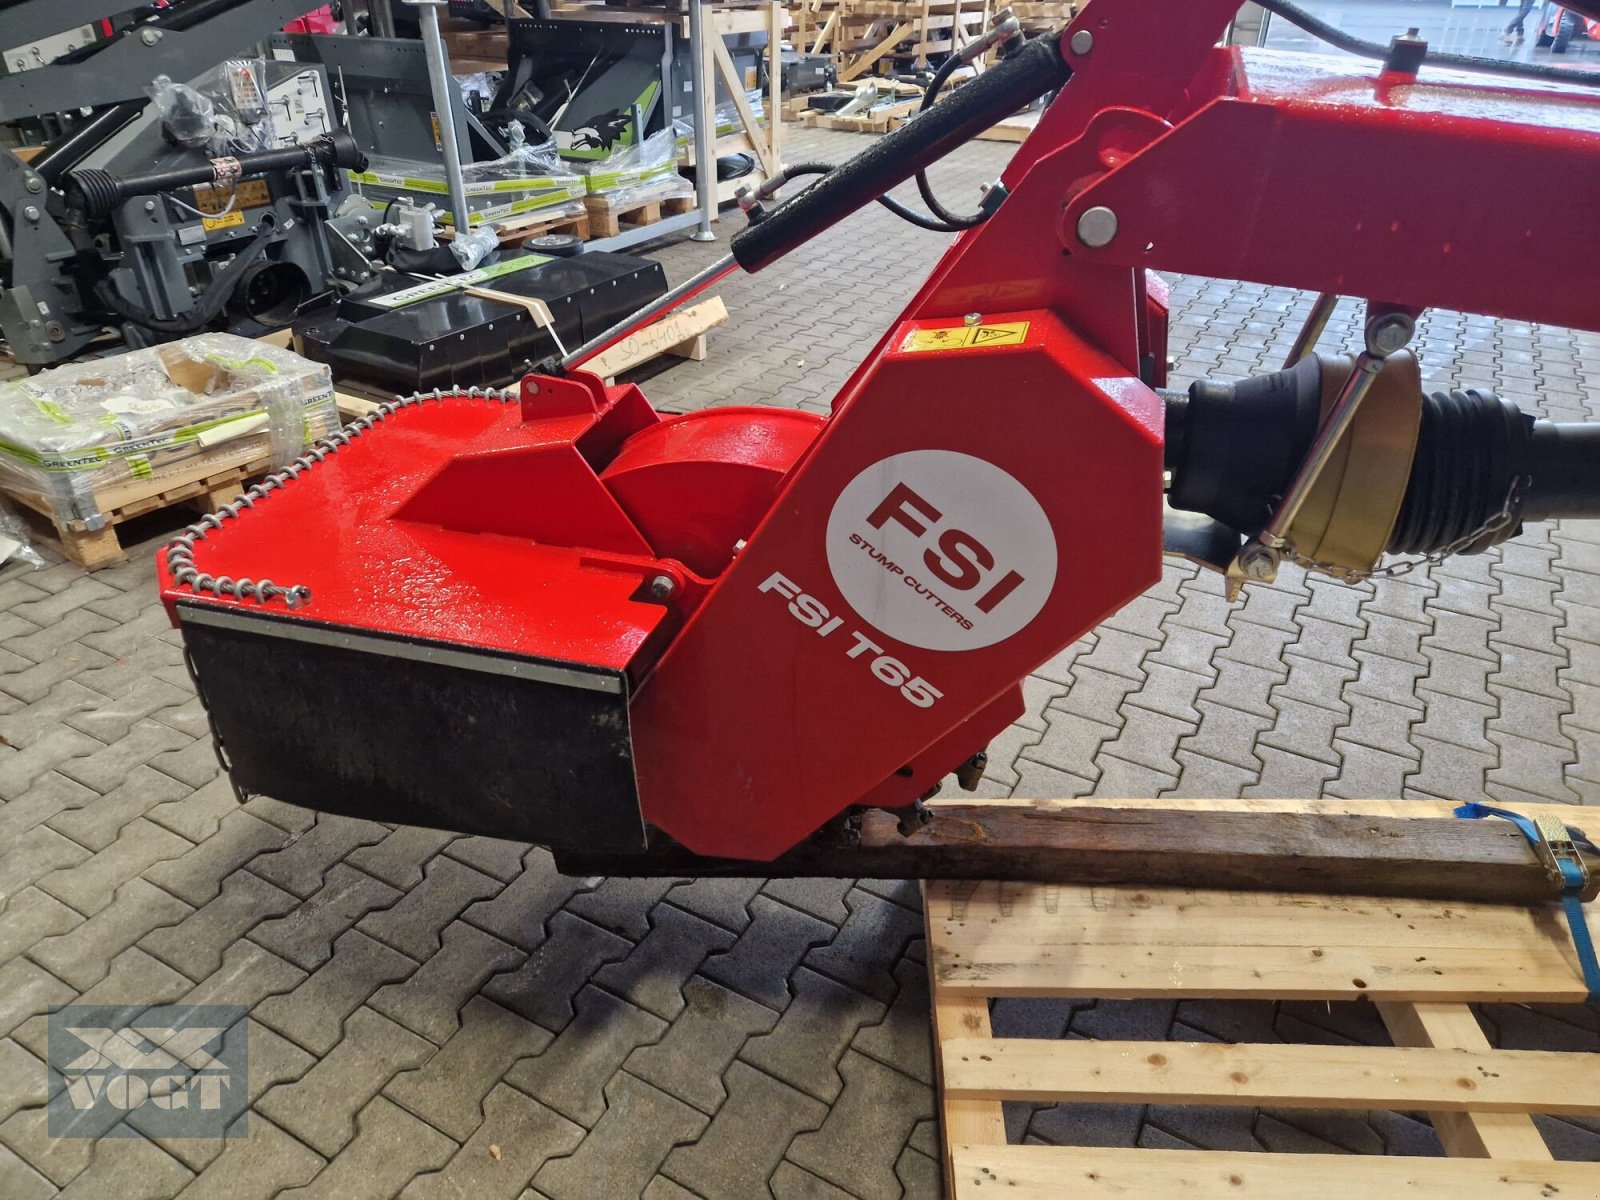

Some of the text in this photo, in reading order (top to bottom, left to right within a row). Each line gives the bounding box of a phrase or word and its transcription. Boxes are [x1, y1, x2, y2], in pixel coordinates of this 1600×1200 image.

[849, 533, 975, 631] STUMP CUTTERS
[865, 481, 1026, 615] FSI
[757, 571, 945, 709] FSI T65
